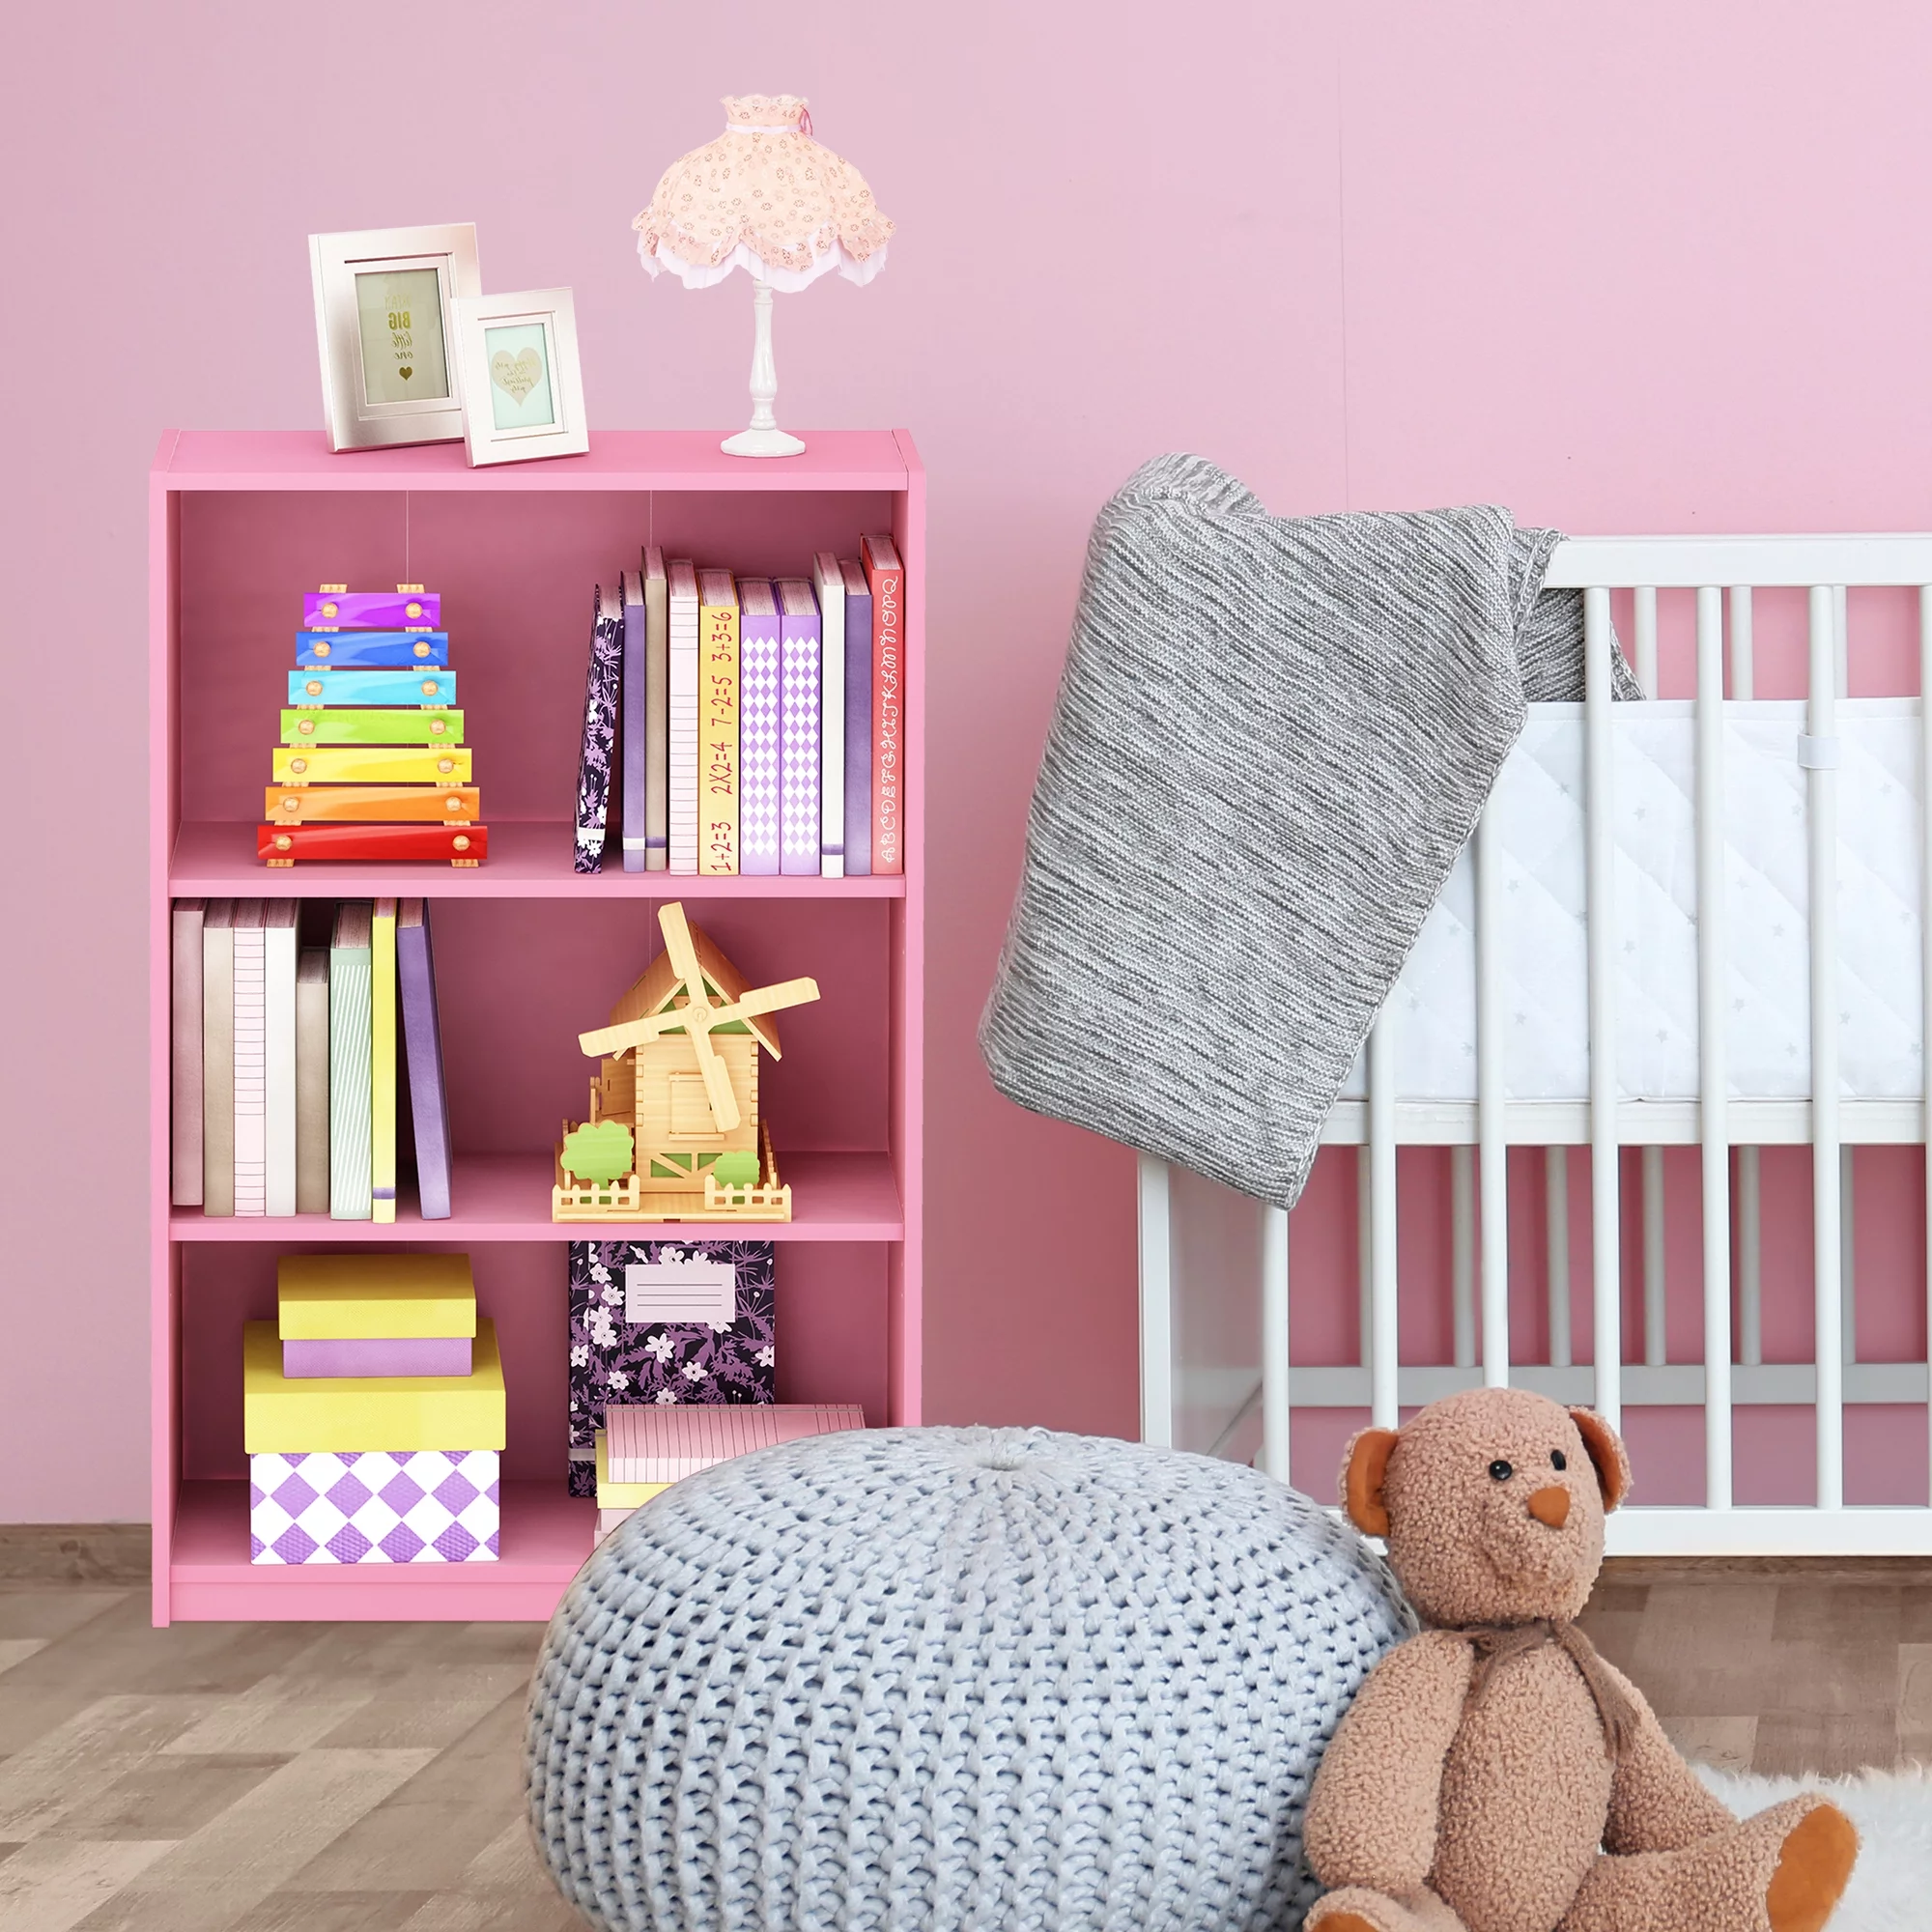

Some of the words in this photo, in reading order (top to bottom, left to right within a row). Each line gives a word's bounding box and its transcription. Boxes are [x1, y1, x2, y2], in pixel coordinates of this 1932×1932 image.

[711, 611, 732, 663] 3+3=6
[711, 675, 733, 726] 7-2=5
[710, 821, 733, 871] 1+2=3
